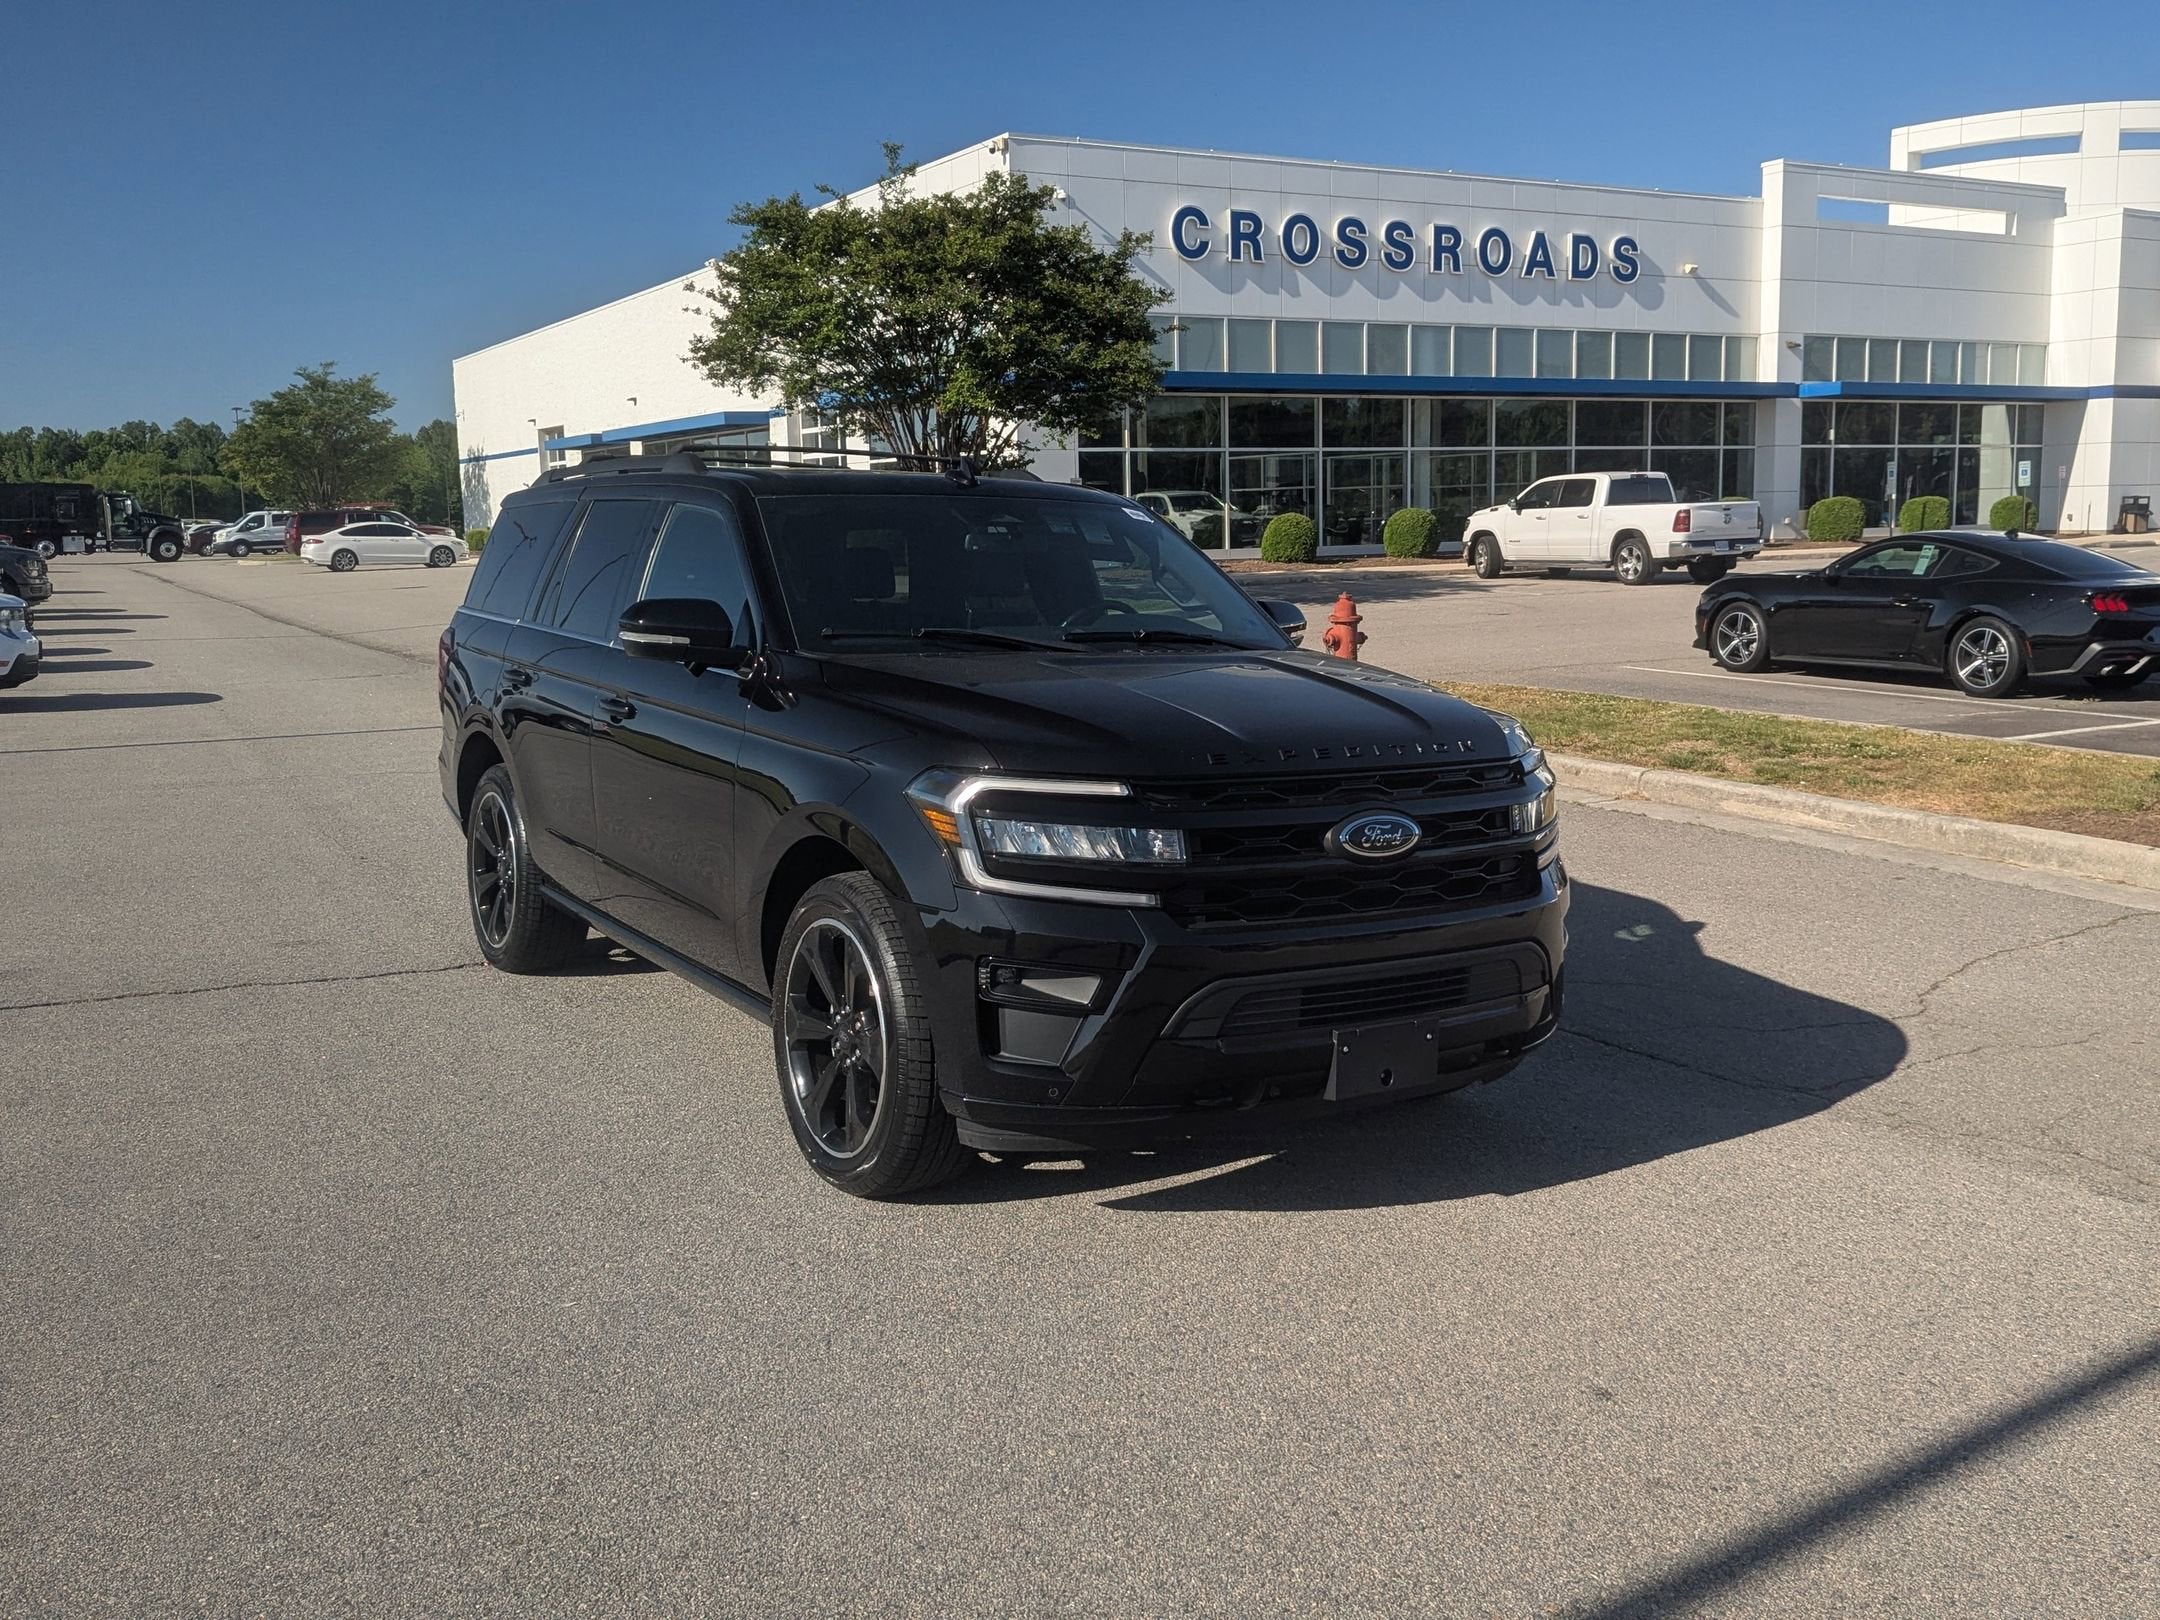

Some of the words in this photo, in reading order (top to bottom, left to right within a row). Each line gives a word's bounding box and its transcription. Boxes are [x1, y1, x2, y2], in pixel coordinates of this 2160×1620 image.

[1169, 204, 1641, 284] CROSSROADS
[1207, 739, 1476, 766] EXPEDITION
[1361, 824, 1406, 848] Ford
